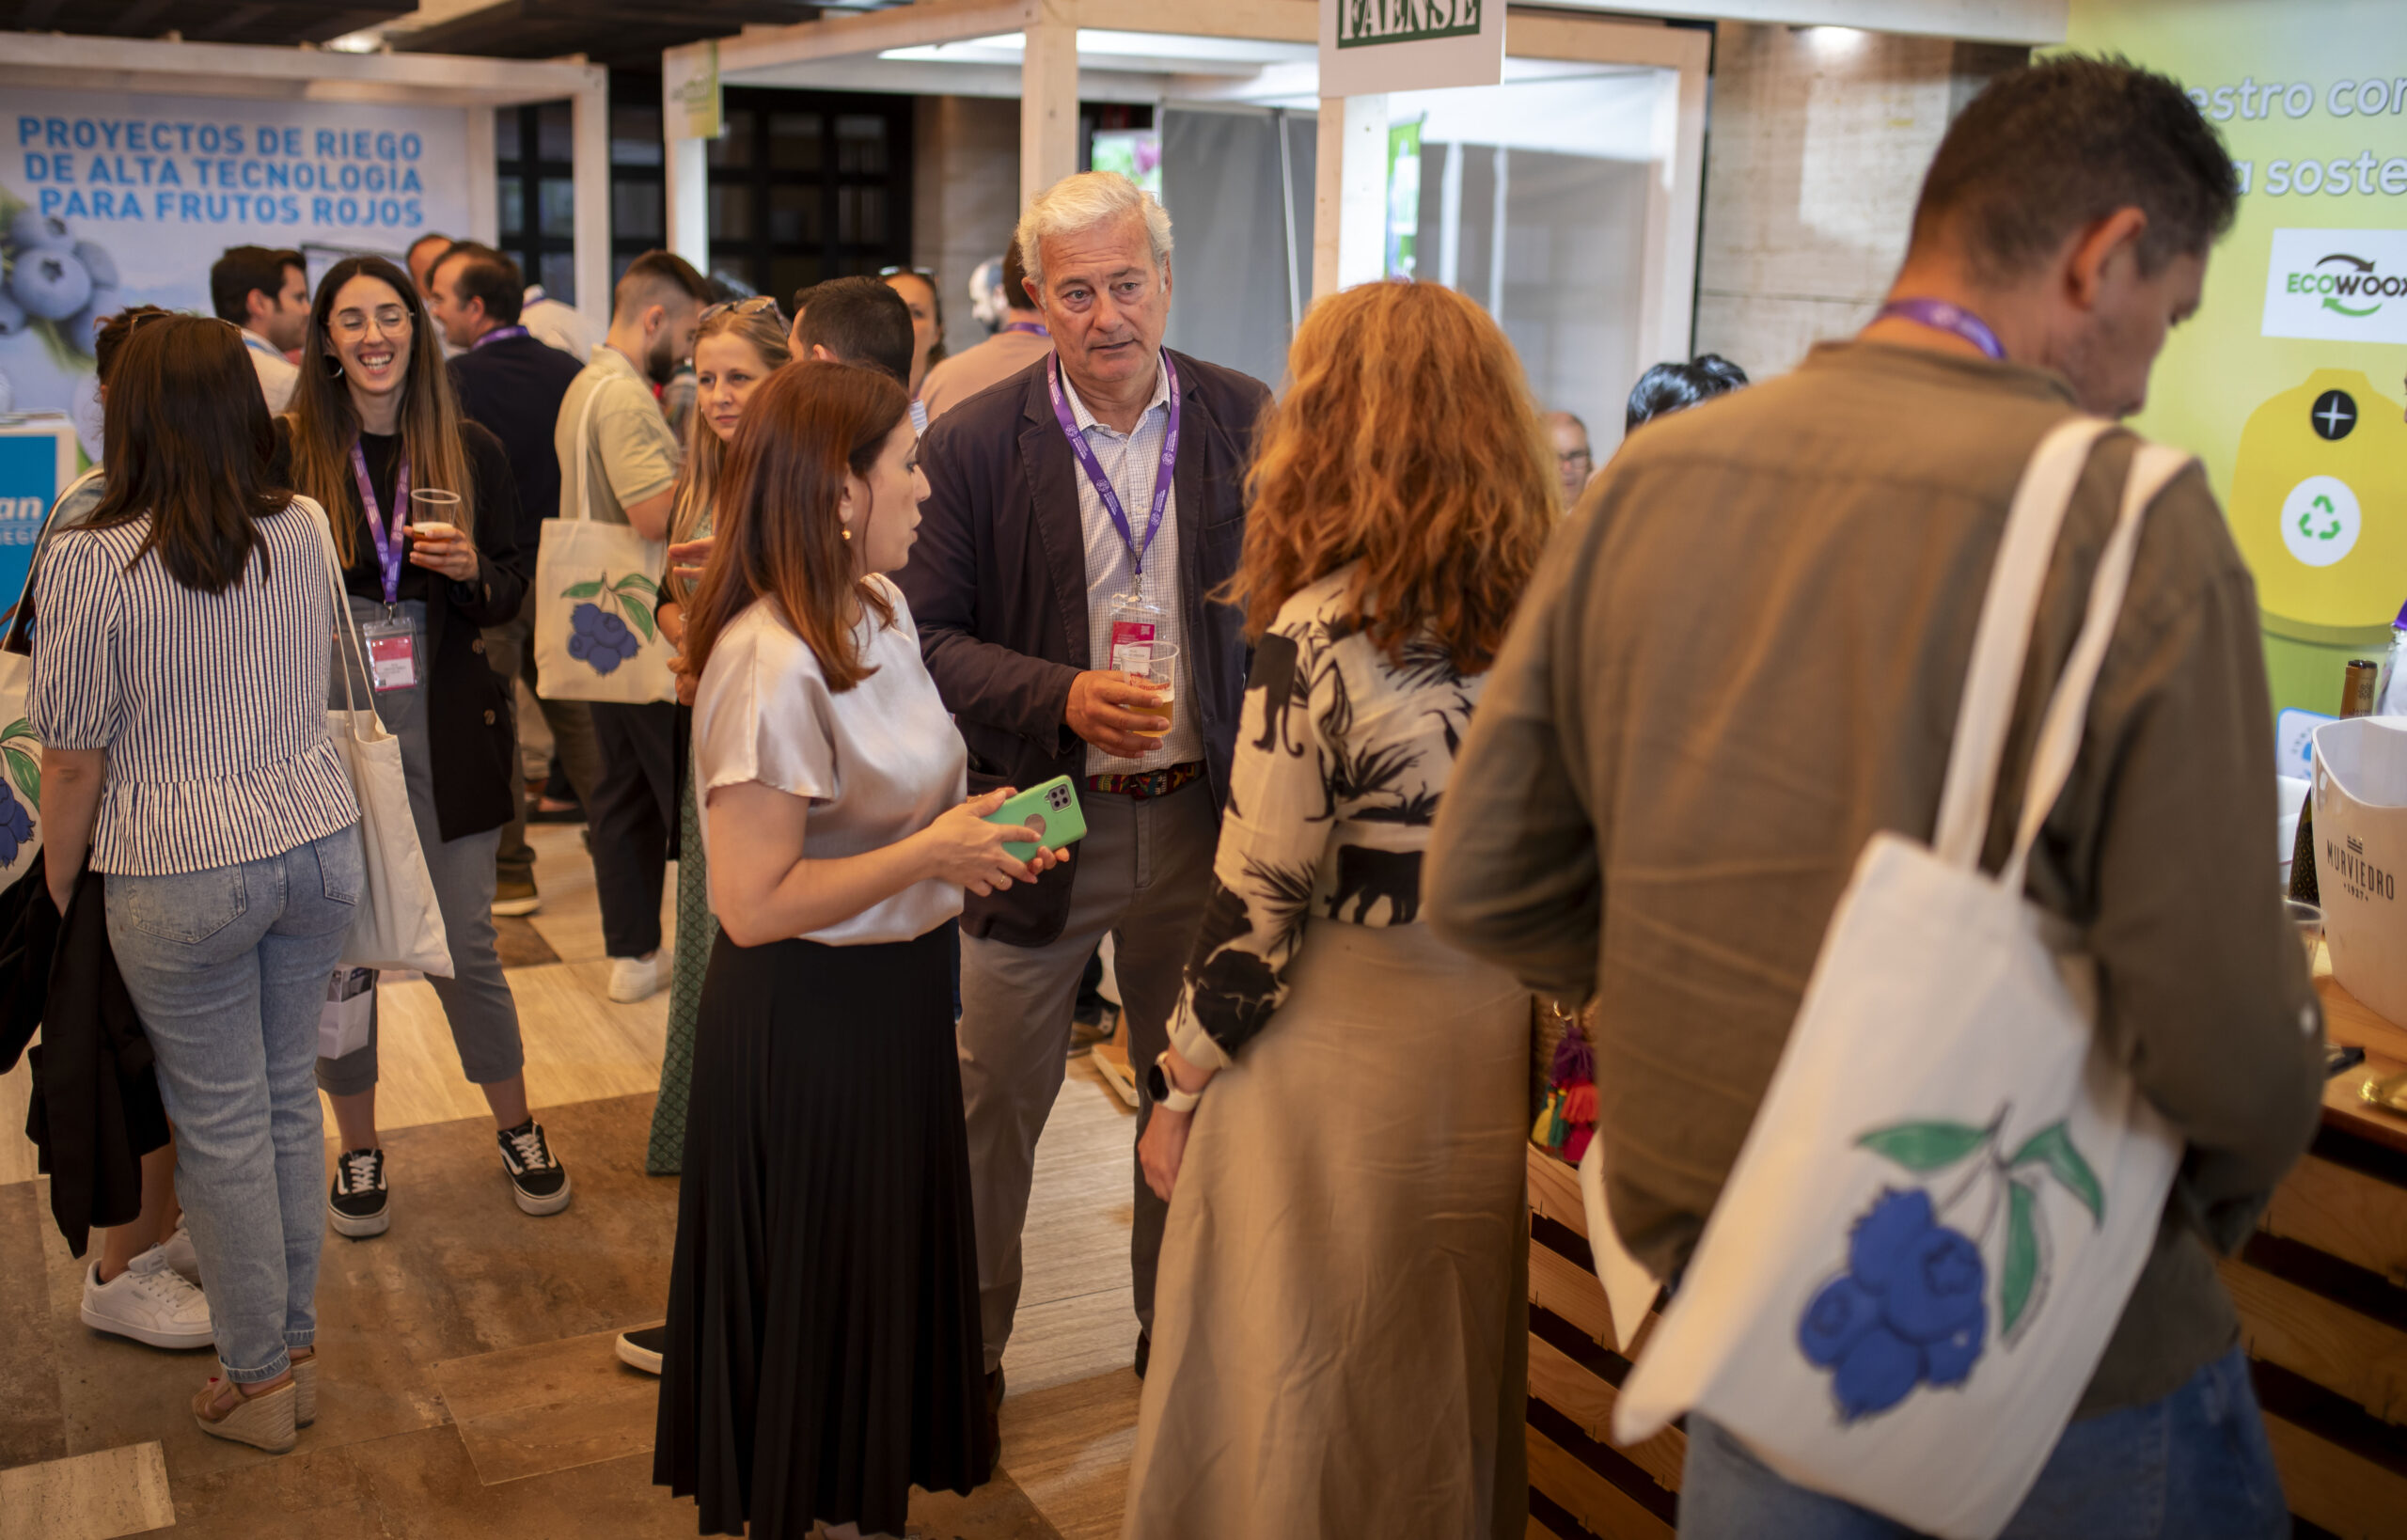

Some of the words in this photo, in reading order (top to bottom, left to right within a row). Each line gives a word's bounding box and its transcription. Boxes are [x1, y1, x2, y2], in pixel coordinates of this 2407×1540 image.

[1341, 0, 1478, 39] FAENSE
[18, 116, 244, 155] PROYECTOS
[257, 126, 303, 157] DE
[315, 129, 422, 162] RIEGO
[24, 153, 74, 182] DE
[88, 155, 181, 186] ALTA
[2264, 150, 2407, 196] soste
[39, 188, 143, 220] PARA
[155, 191, 300, 225] FRUTOS
[312, 196, 423, 228] ROJOS
[2327, 839, 2394, 901] MURVIEDRO
